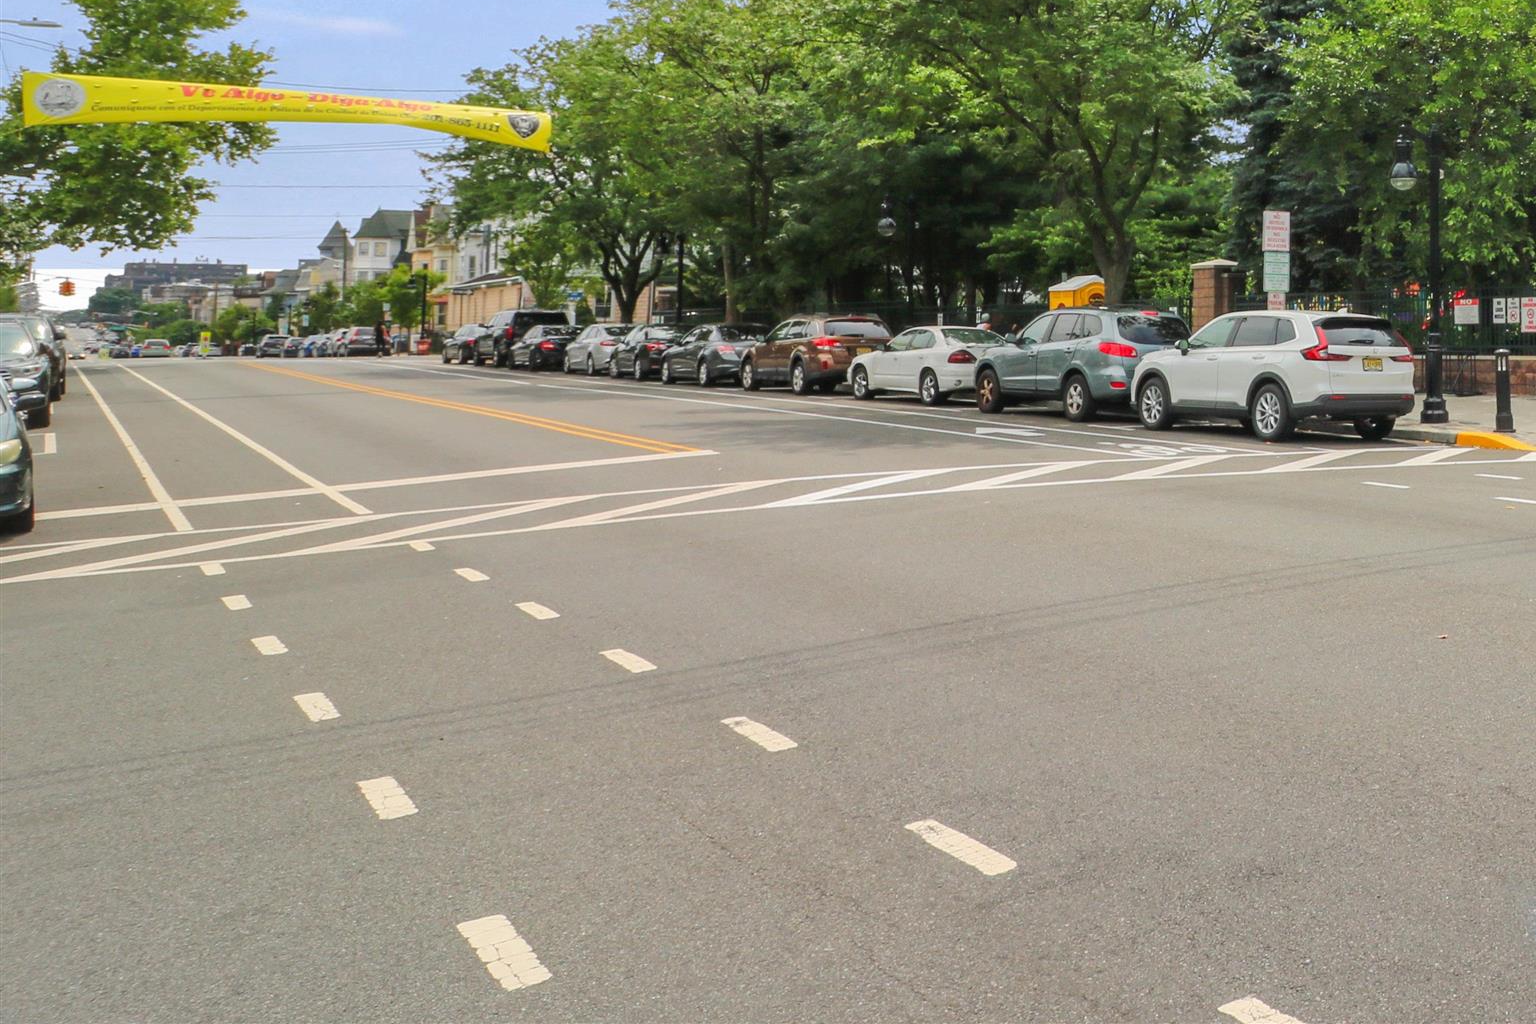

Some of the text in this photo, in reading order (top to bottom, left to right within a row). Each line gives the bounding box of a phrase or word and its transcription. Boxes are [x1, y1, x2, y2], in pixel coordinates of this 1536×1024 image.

[180, 85, 216, 98] Ve
[221, 87, 286, 102] Algo
[307, 93, 370, 108] Diga
